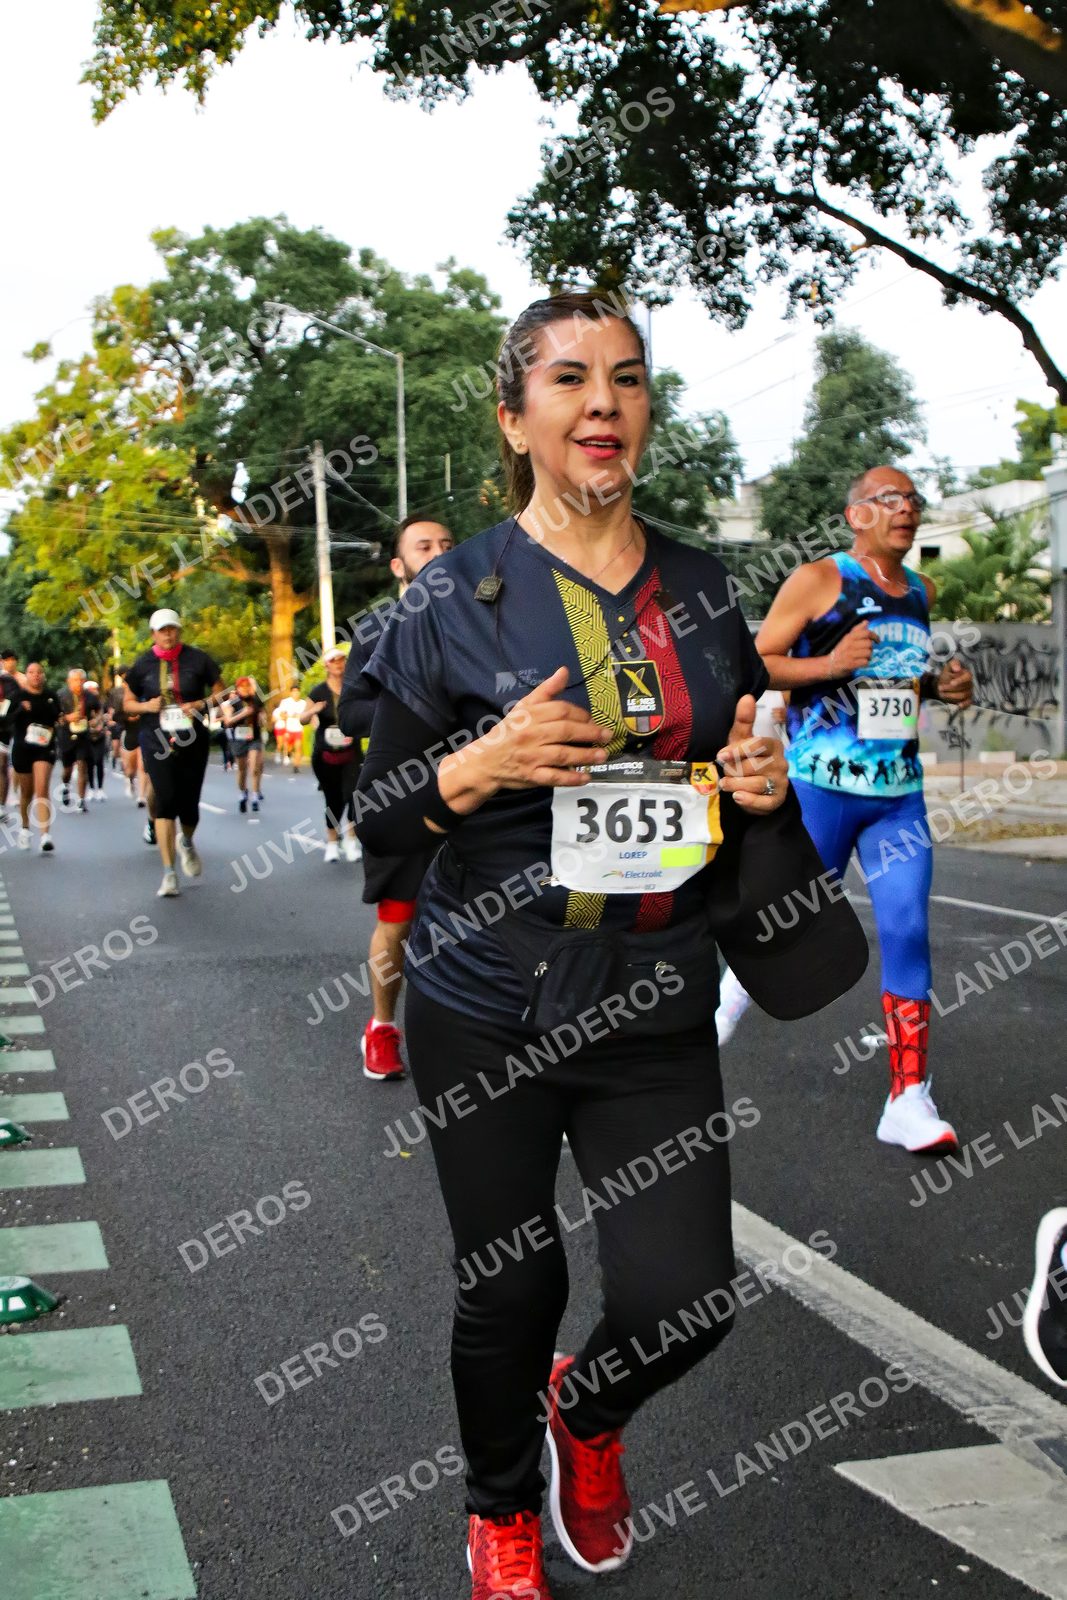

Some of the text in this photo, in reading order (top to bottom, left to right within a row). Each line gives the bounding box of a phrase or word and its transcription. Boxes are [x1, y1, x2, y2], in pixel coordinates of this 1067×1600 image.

[869, 697, 912, 717] 3730
[694, 767, 713, 782] 5K
[575, 797, 684, 844] 3653
[618, 851, 649, 860] LOREP
